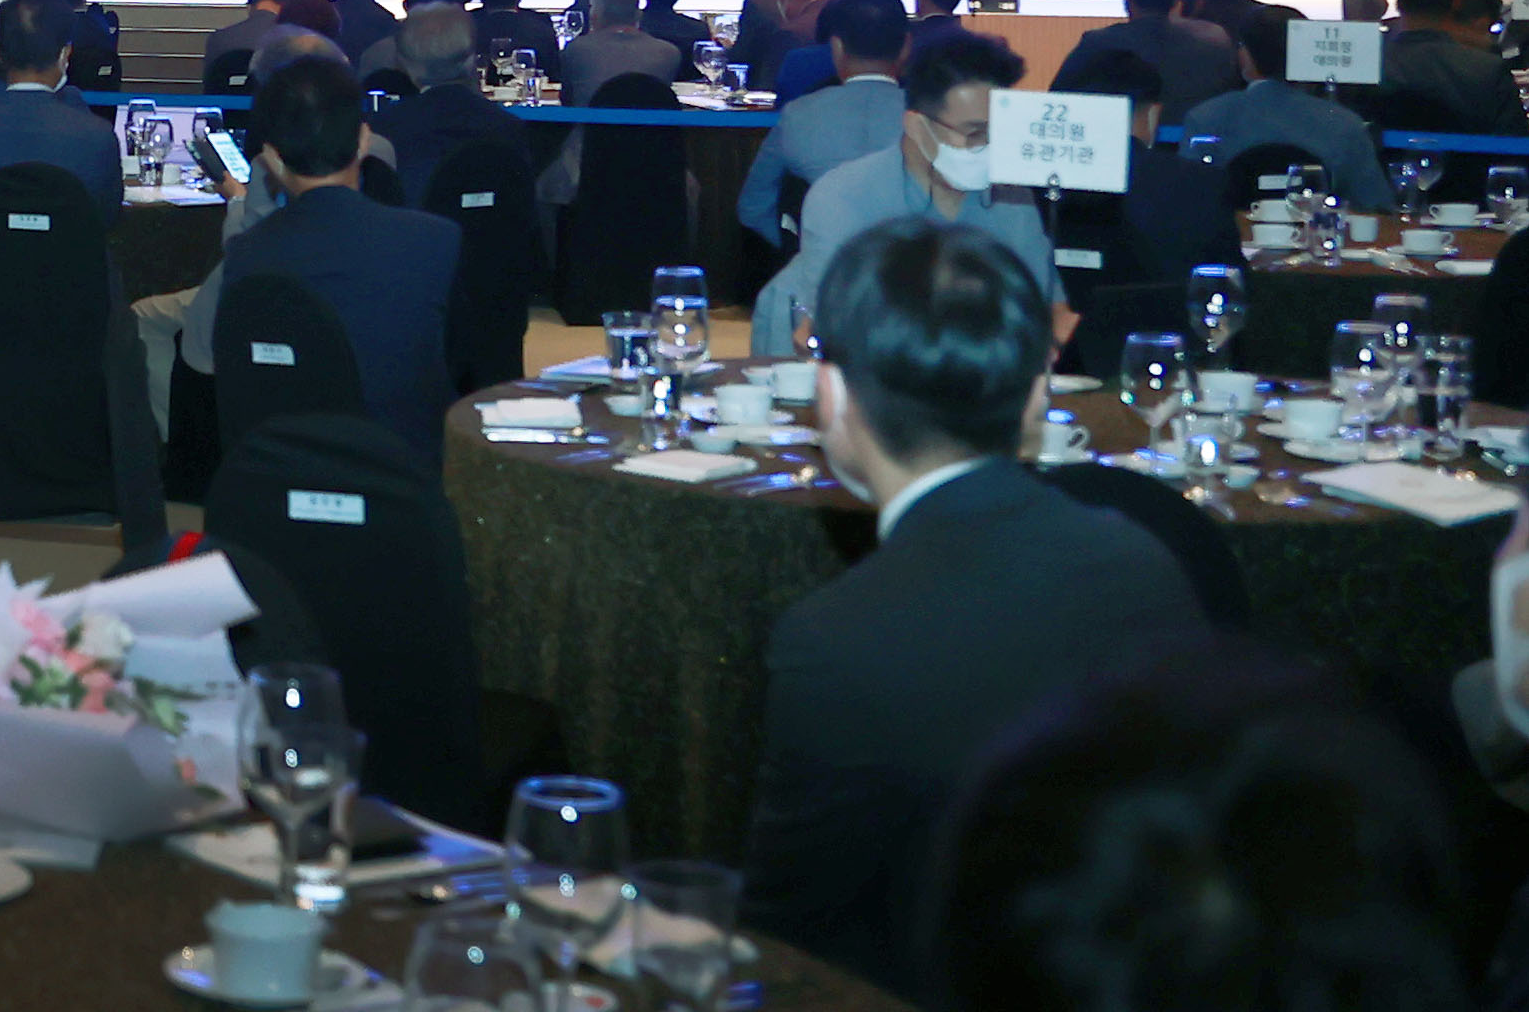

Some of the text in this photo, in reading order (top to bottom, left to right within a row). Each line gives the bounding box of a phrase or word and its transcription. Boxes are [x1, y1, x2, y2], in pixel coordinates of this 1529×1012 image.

[1042, 103, 1069, 123] 22
[1030, 121, 1086, 142] 대의원
[1022, 141, 1094, 164] 유관기관
